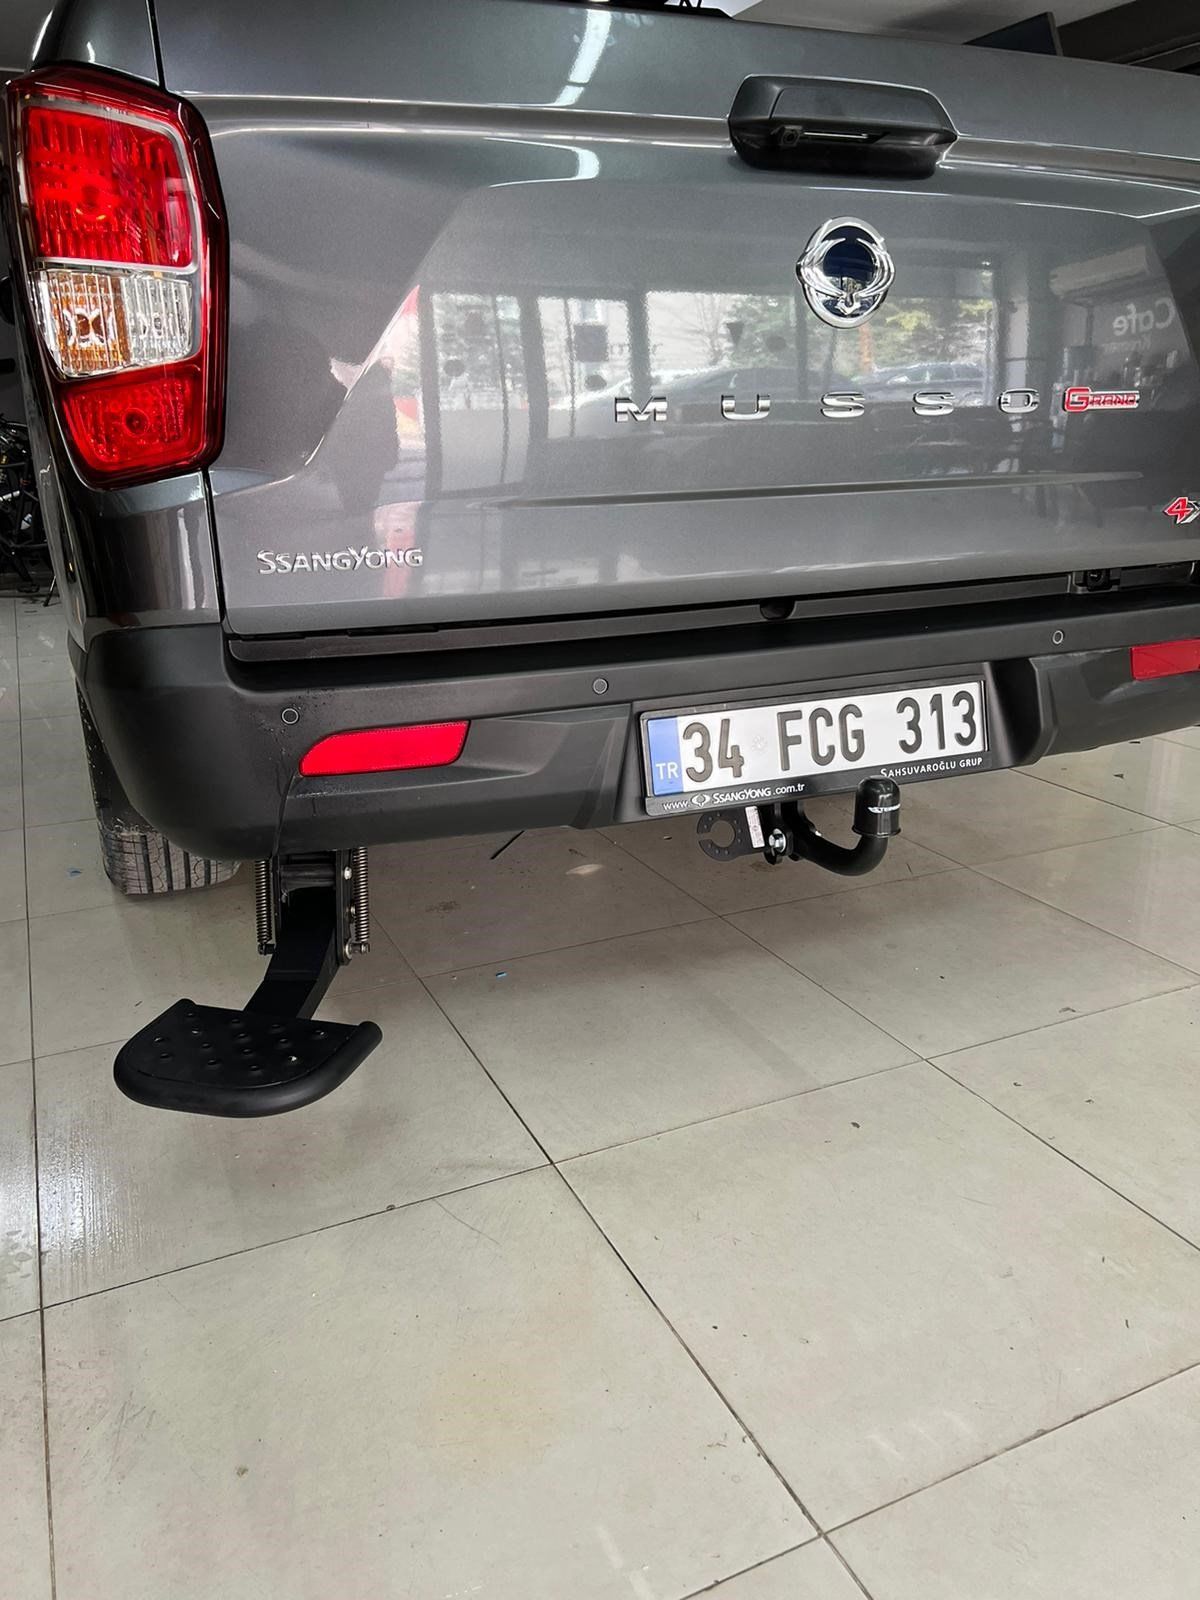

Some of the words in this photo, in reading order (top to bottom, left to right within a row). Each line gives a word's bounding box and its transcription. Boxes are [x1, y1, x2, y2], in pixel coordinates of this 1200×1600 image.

[614, 387, 1040, 422] MUSSO
[256, 545, 423, 575] SSANGYONG
[683, 718, 745, 783] 34
[777, 703, 866, 772] FCG
[896, 690, 977, 755] 313
[656, 763, 679, 780] TR
[959, 757, 983, 768] GRUP
[712, 787, 772, 804] SSANGYONG
